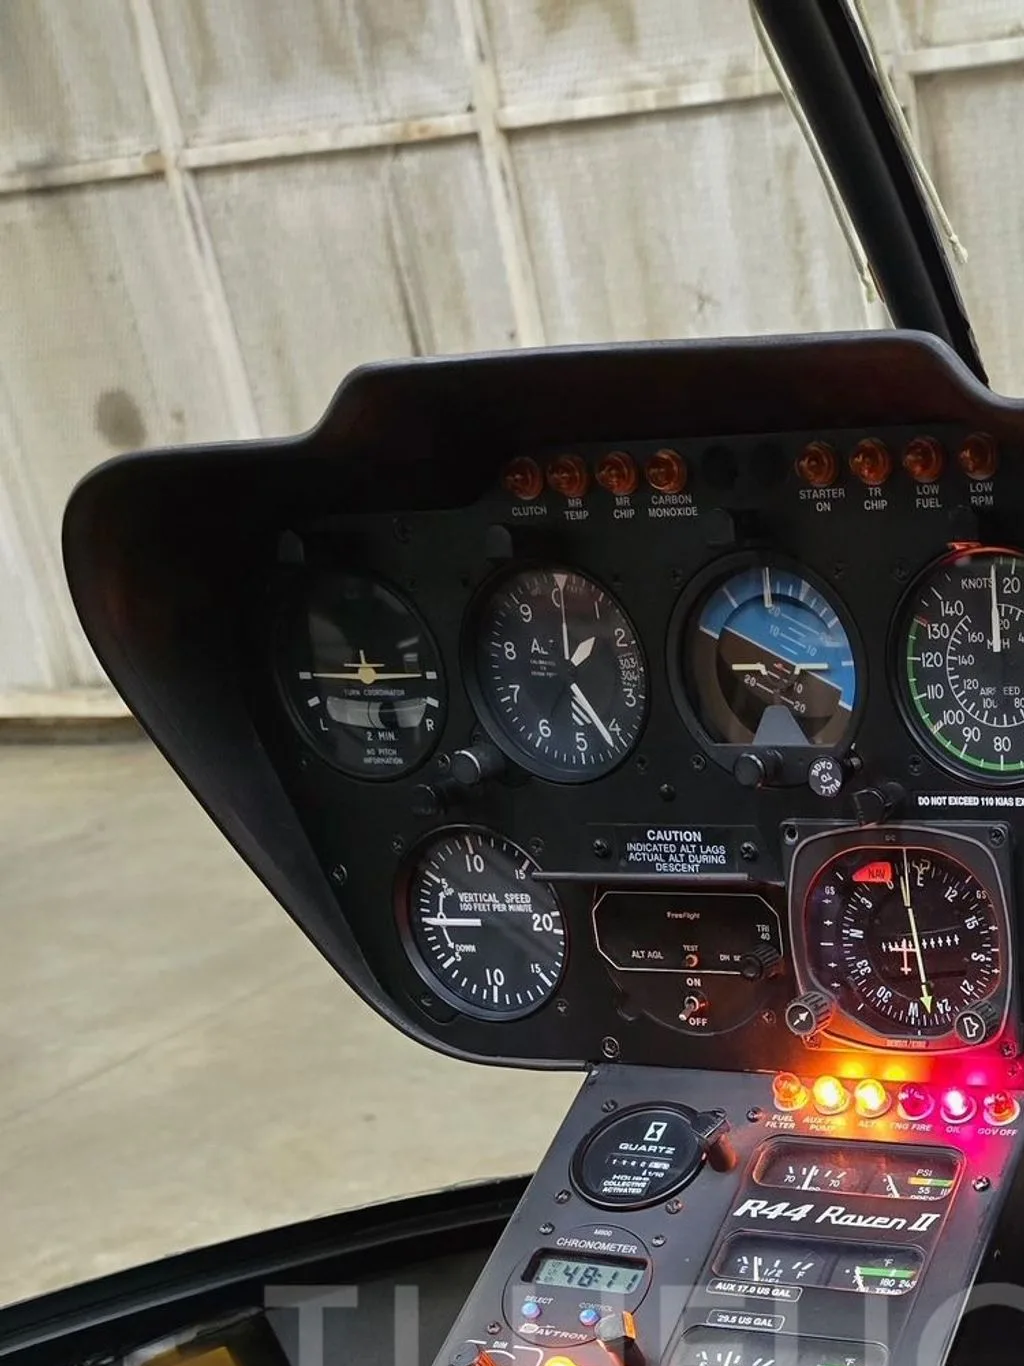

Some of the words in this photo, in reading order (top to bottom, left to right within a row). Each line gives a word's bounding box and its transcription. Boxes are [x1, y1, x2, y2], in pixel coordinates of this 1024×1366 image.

[799, 487, 846, 500] STARTER
[916, 484, 940, 496] LOW
[969, 482, 994, 493] LOW
[651, 494, 692, 505] CARBON
[863, 500, 888, 511] CHIP
[916, 498, 942, 509] FUEL
[970, 494, 994, 506] RPM
[512, 506, 547, 517] CLUTCH
[648, 506, 699, 518] MONOXIDE
[816, 501, 831, 512] ON
[564, 510, 589, 521] TEMP
[613, 508, 635, 519] CHIP
[940, 601, 964, 617] 140
[927, 623, 949, 639] 130
[921, 652, 943, 668] 120
[963, 727, 981, 742] 90
[993, 737, 1011, 751] 80
[918, 796, 930, 806] DO
[931, 796, 947, 806] NOT
[948, 796, 979, 806] EXCEED
[647, 829, 702, 842] CAUTION
[627, 843, 677, 853] INDICATED
[680, 844, 696, 854] ALT
[700, 845, 726, 855] LAGS
[465, 854, 484, 872] 10
[628, 853, 665, 863] ACTUAL
[668, 854, 685, 863] ALT
[688, 854, 726, 865] DURING
[655, 863, 701, 873] DESCENT
[458, 892, 499, 903] VERTICAL
[504, 893, 531, 904] SPEED
[532, 914, 552, 931] 20
[486, 968, 504, 986] 10
[686, 978, 701, 987] ON
[689, 1017, 707, 1026] OFF
[765, 1120, 796, 1130] FILTER
[618, 1142, 675, 1155] QUARTZ
[733, 1198, 815, 1222] R44
[815, 1205, 908, 1231] Raven
[556, 1238, 638, 1255] CHRONOMETER
[715, 1281, 735, 1292] AUX
[737, 1284, 756, 1294] 17.0
[757, 1285, 770, 1295] US
[772, 1287, 792, 1298] GAL
[738, 1316, 752, 1326] US
[753, 1317, 773, 1328] GAL
